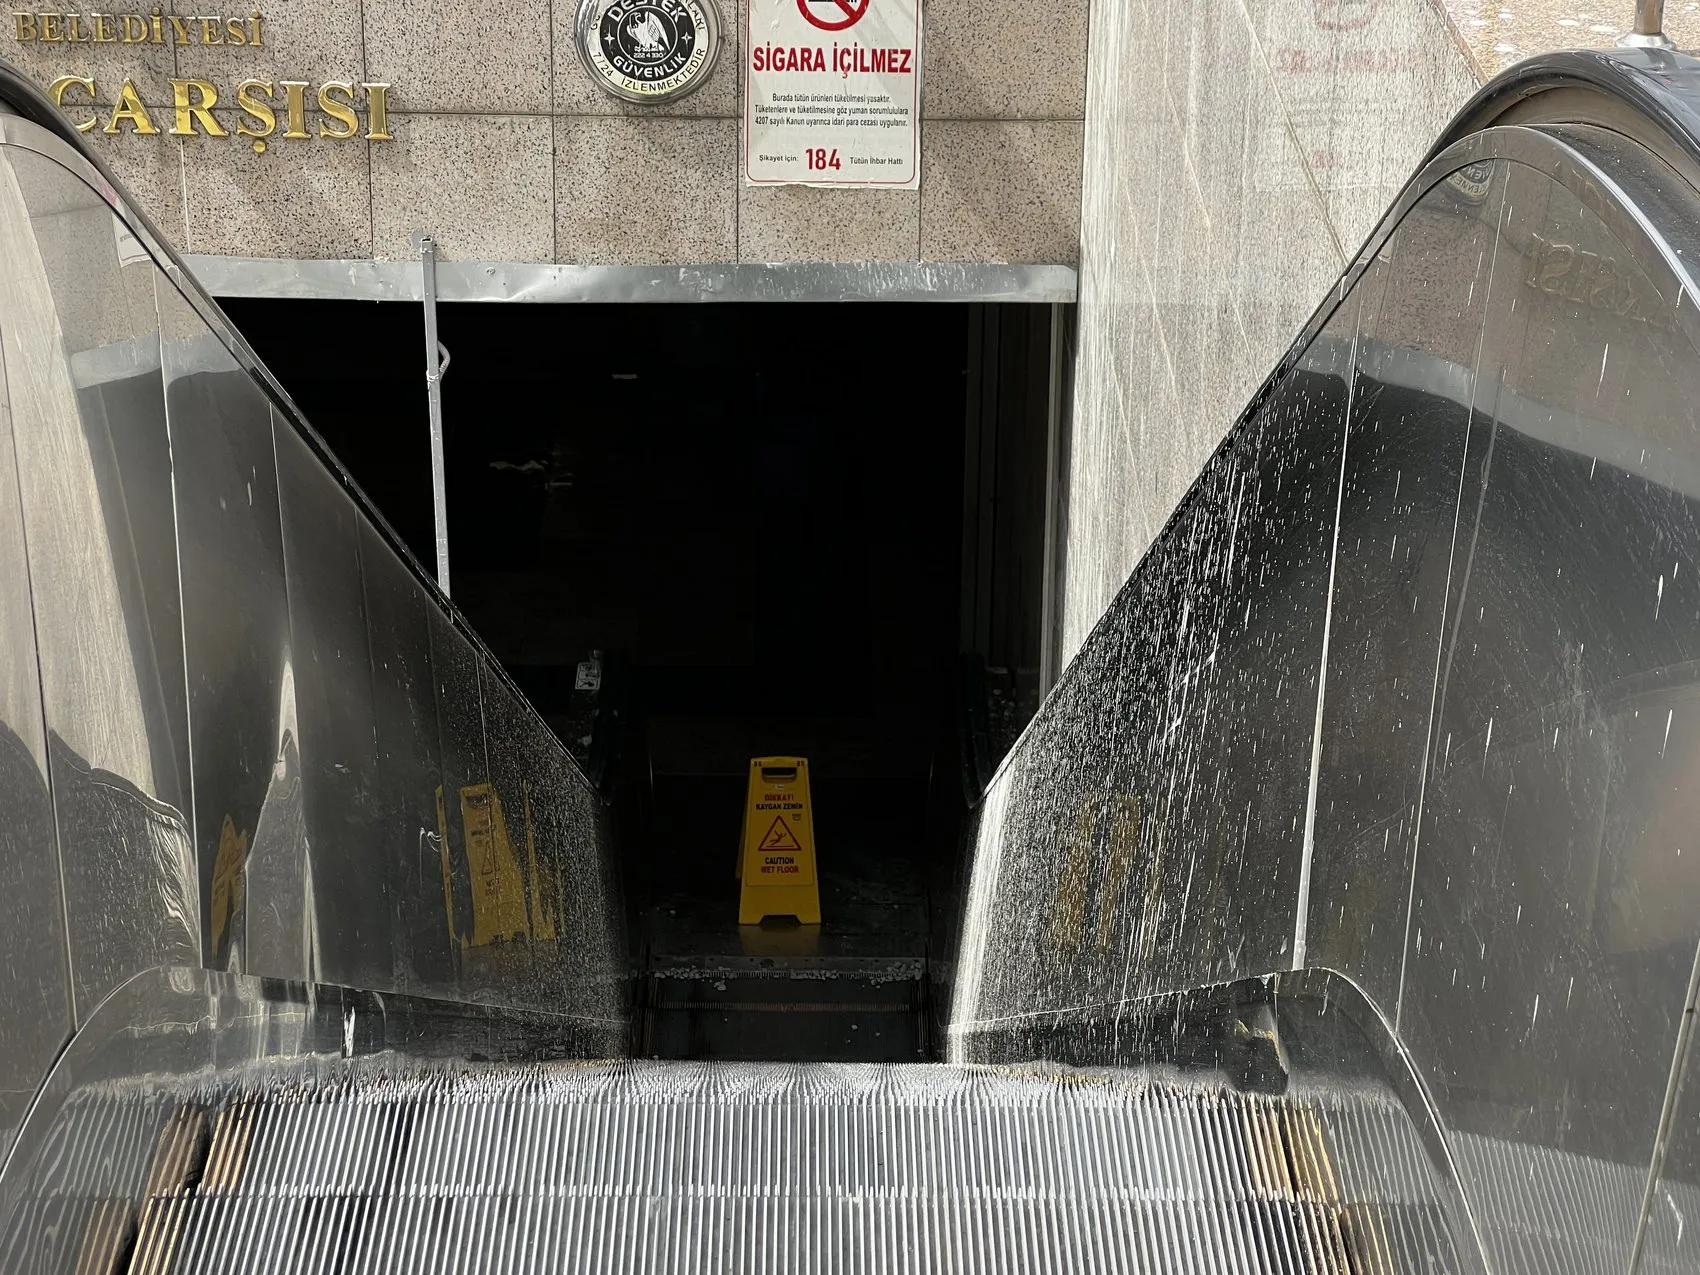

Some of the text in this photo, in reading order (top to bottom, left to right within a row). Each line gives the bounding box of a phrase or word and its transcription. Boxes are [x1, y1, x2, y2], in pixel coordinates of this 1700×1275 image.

[13, 7, 264, 46] BELEDİYESİ
[753, 41, 912, 79] SİGARA İÇİLMEZ
[772, 93, 793, 102] Burada
[794, 94, 809, 102] tütün
[810, 93, 834, 102] ürünleri
[834, 93, 865, 103] tüketilmesi
[755, 104, 788, 114] Tüketenlere
[797, 105, 835, 114] tüketilmesine
[836, 106, 847, 116] göz
[848, 107, 868, 117] yuman
[755, 116, 768, 125] 4207
[769, 116, 785, 127] sayılı
[786, 117, 805, 125] Kanun
[831, 117, 845, 126] idari
[846, 119, 859, 128] para
[860, 119, 878, 127] cezası
[759, 154, 784, 163] Şikayet
[805, 148, 841, 171] 184
[850, 156, 869, 165] Tütün
[869, 156, 887, 165] İhbar
[765, 856, 795, 865] CAUTION
[761, 865, 799, 874] WET FLOOR
